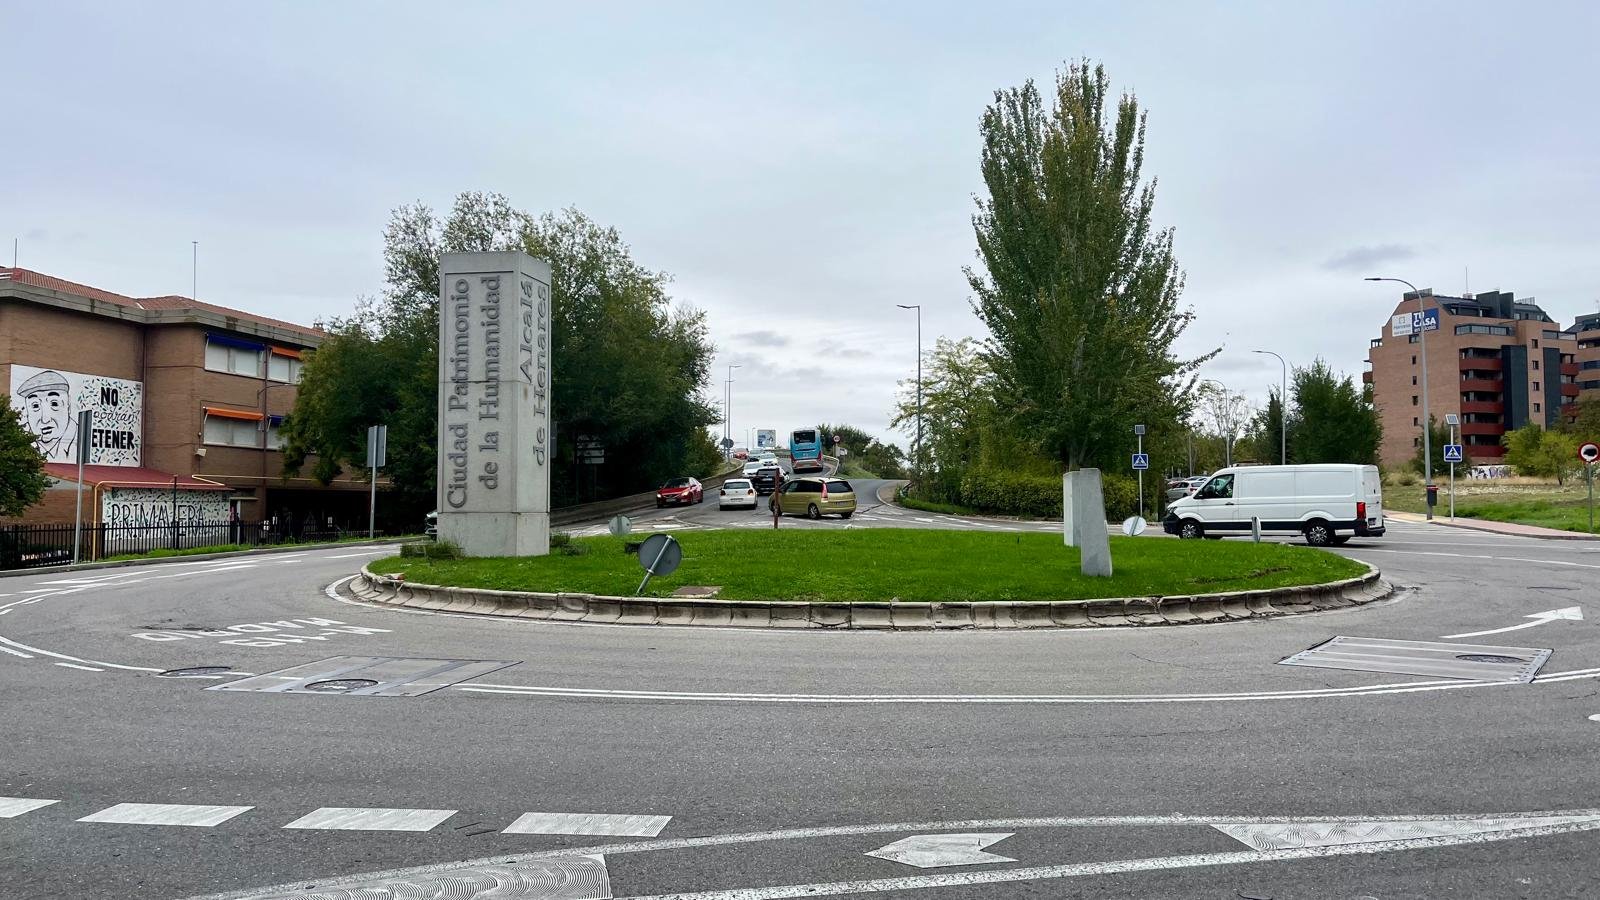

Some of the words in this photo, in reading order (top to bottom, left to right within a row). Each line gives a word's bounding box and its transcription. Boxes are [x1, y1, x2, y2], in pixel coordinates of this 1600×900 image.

[448, 278, 470, 412] Patrimonio
[479, 275, 501, 421] Humanidad
[520, 280, 534, 384] Alcalá
[533, 287, 547, 417] Henares
[101, 387, 118, 407] NO
[92, 429, 135, 449] ETENER
[479, 431, 499, 452] la
[533, 429, 545, 466] de
[447, 423, 469, 509] Ciudad
[478, 461, 498, 490] de
[130, 617, 347, 641] MADRID
[218, 626, 393, 647] M-119
